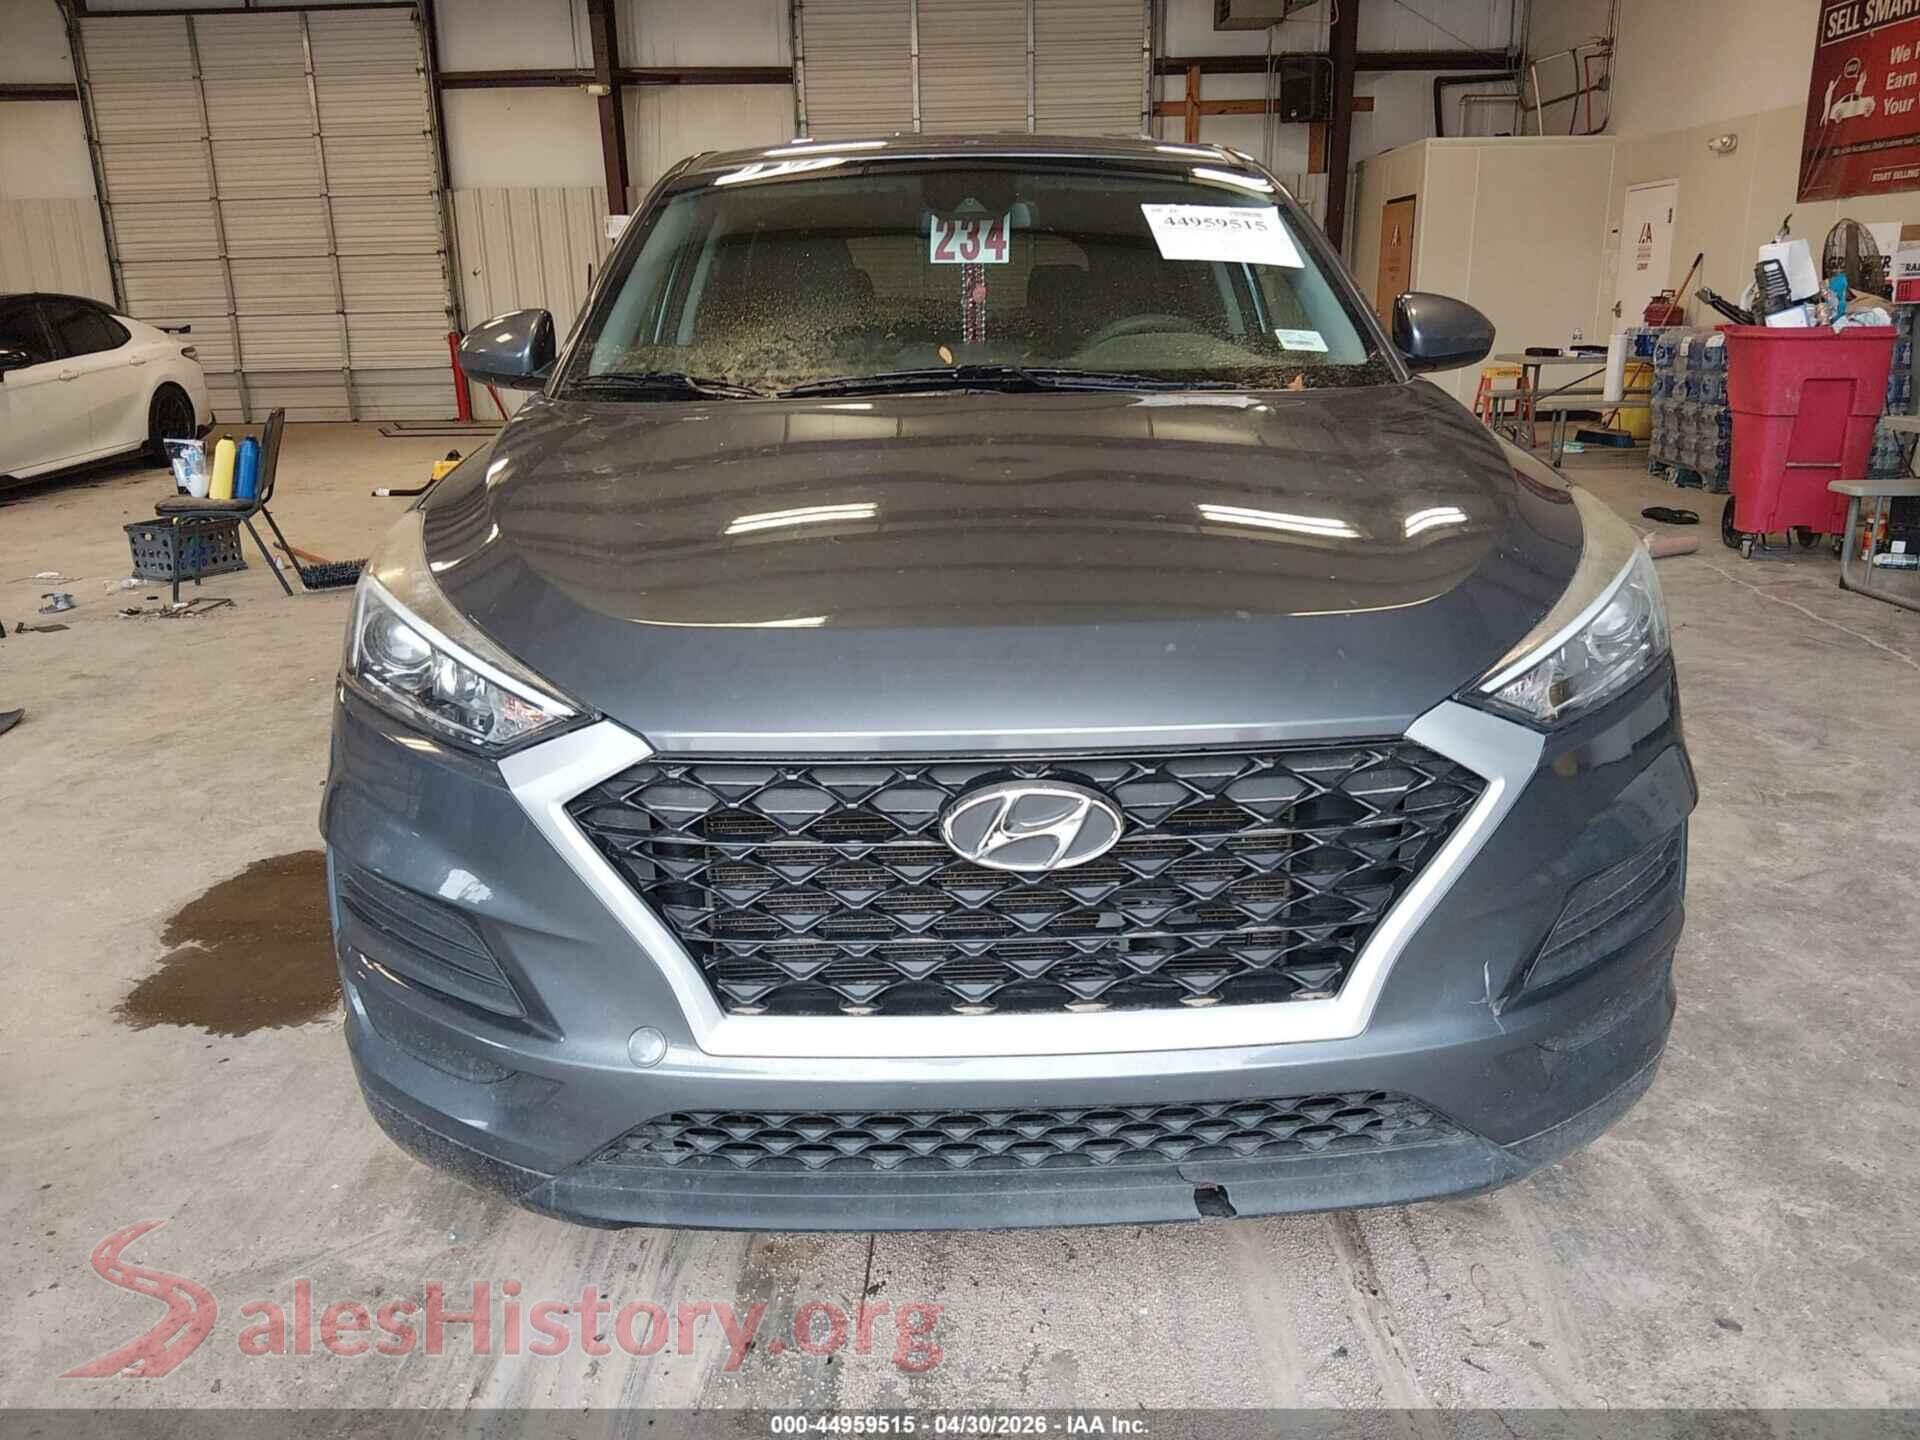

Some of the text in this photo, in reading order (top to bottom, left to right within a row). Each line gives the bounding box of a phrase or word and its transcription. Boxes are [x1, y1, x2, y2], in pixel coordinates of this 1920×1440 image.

[1826, 4, 1860, 38] SELL
[1890, 44, 1912, 65] We
[1886, 71, 1918, 91] Earn
[1884, 97, 1916, 116] Your
[1871, 171, 1892, 182] START
[1164, 216, 1268, 231] 44959515
[934, 219, 1007, 261] 234
